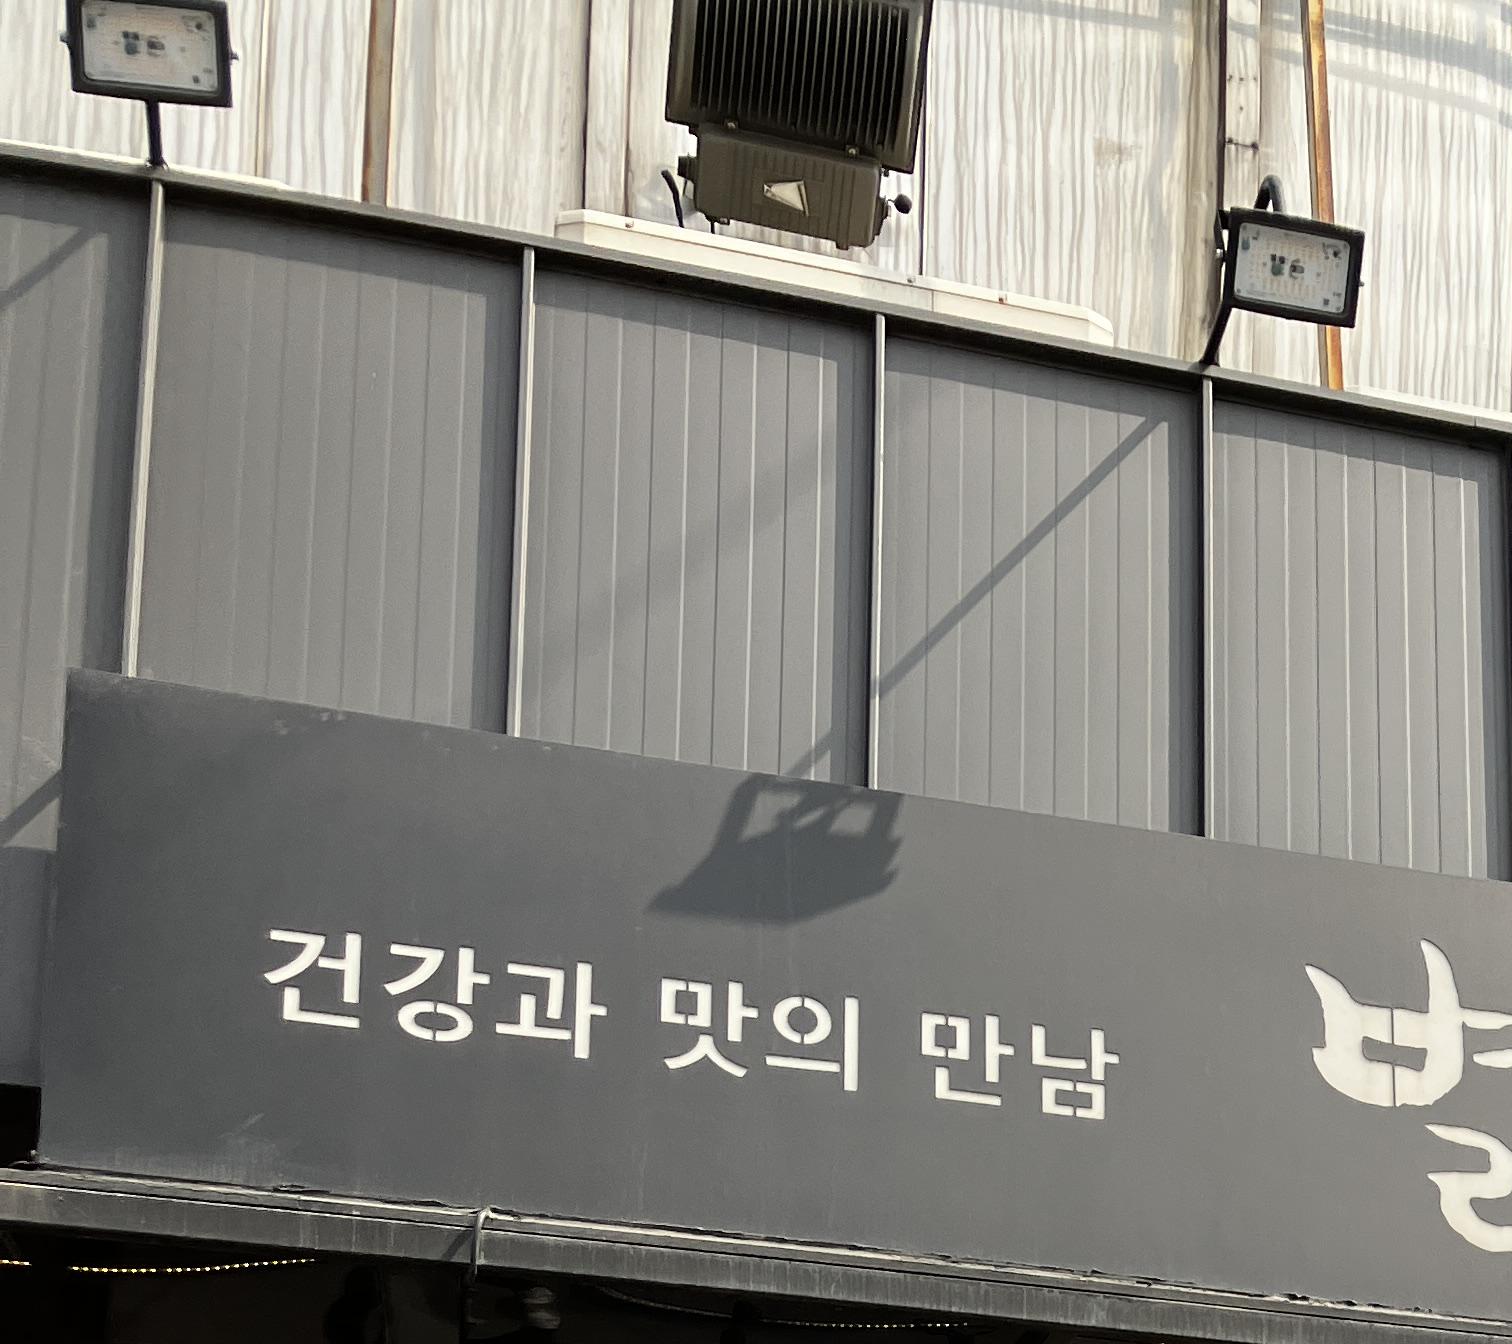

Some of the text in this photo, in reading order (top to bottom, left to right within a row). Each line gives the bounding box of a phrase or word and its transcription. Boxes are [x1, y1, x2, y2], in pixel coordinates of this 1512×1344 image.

[263, 928, 1121, 1121] 건강과 맛의 만남
